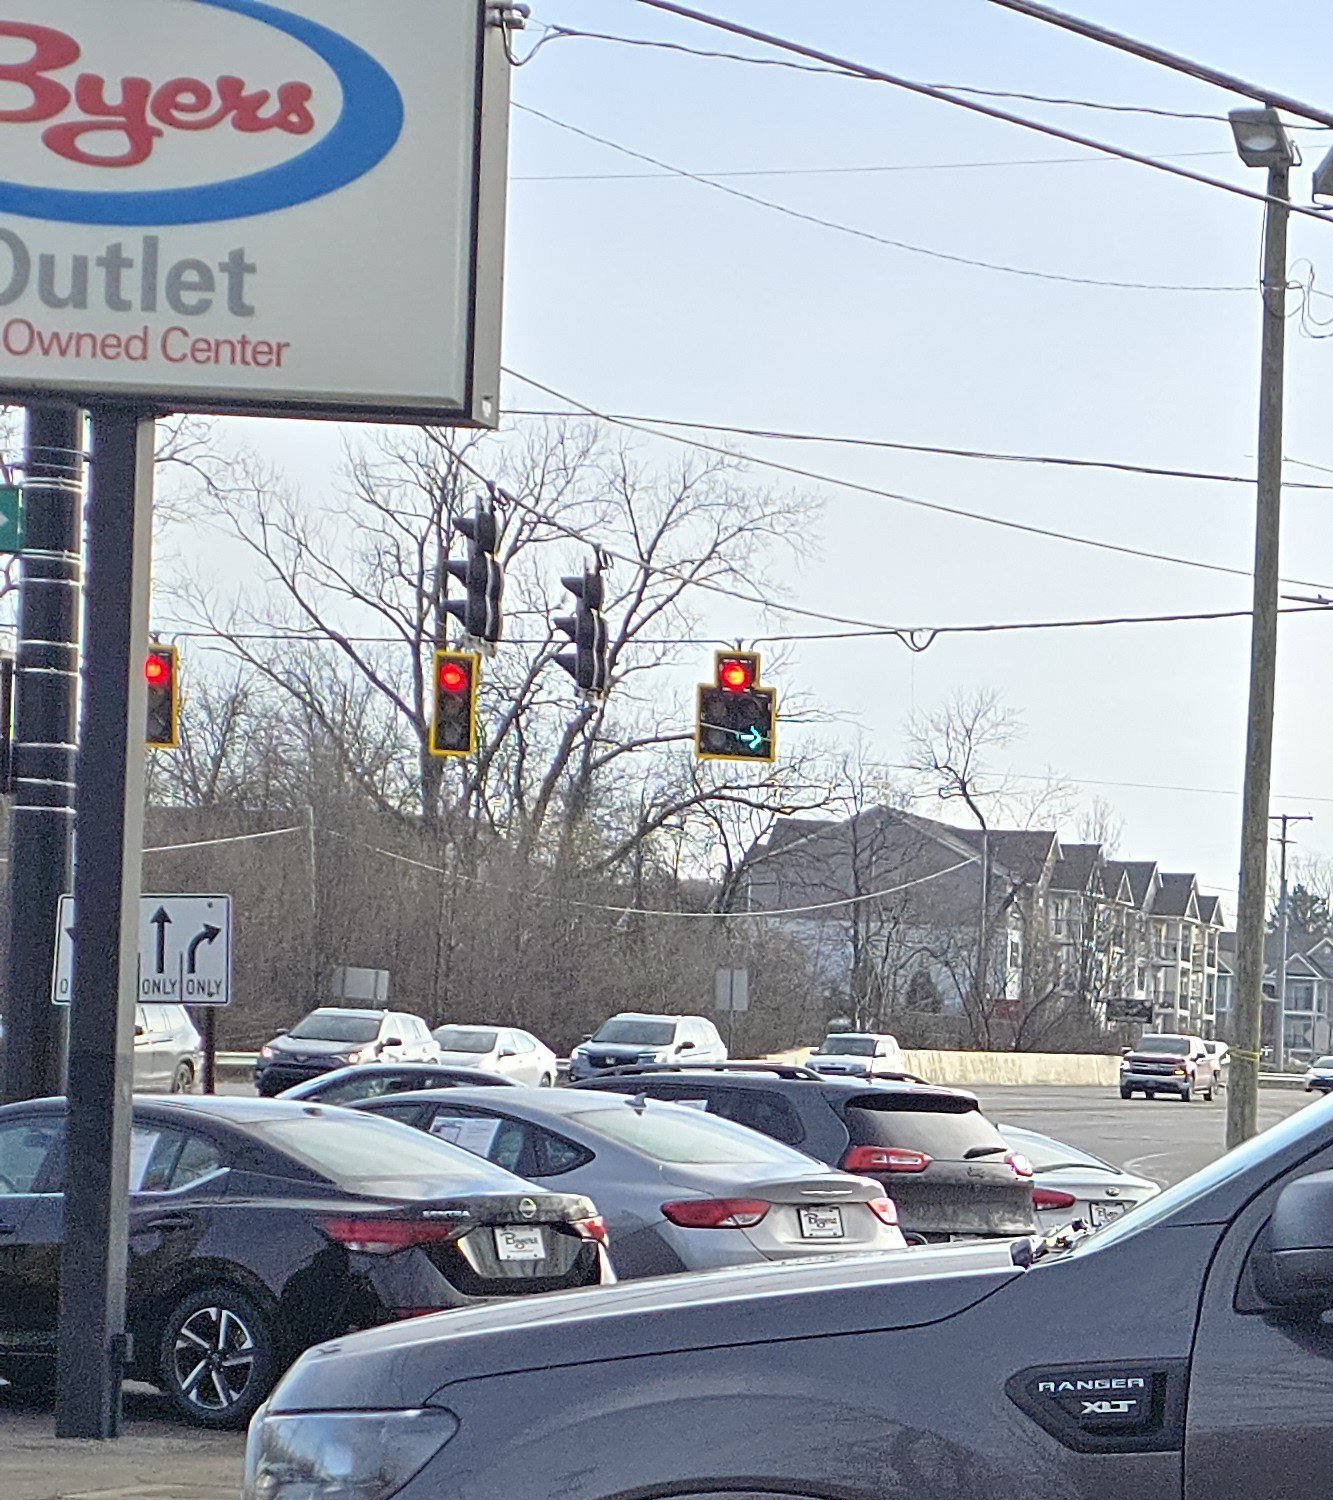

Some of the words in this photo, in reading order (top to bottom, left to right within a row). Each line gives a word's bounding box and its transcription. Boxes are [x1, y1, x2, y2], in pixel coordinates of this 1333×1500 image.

[2, 317, 149, 361] Owned
[161, 326, 291, 368] Center
[142, 979, 177, 995] ONLY
[187, 979, 222, 997] ONLY
[1038, 1378, 1144, 1392] RANGER
[1081, 1400, 1137, 1414] XLT
